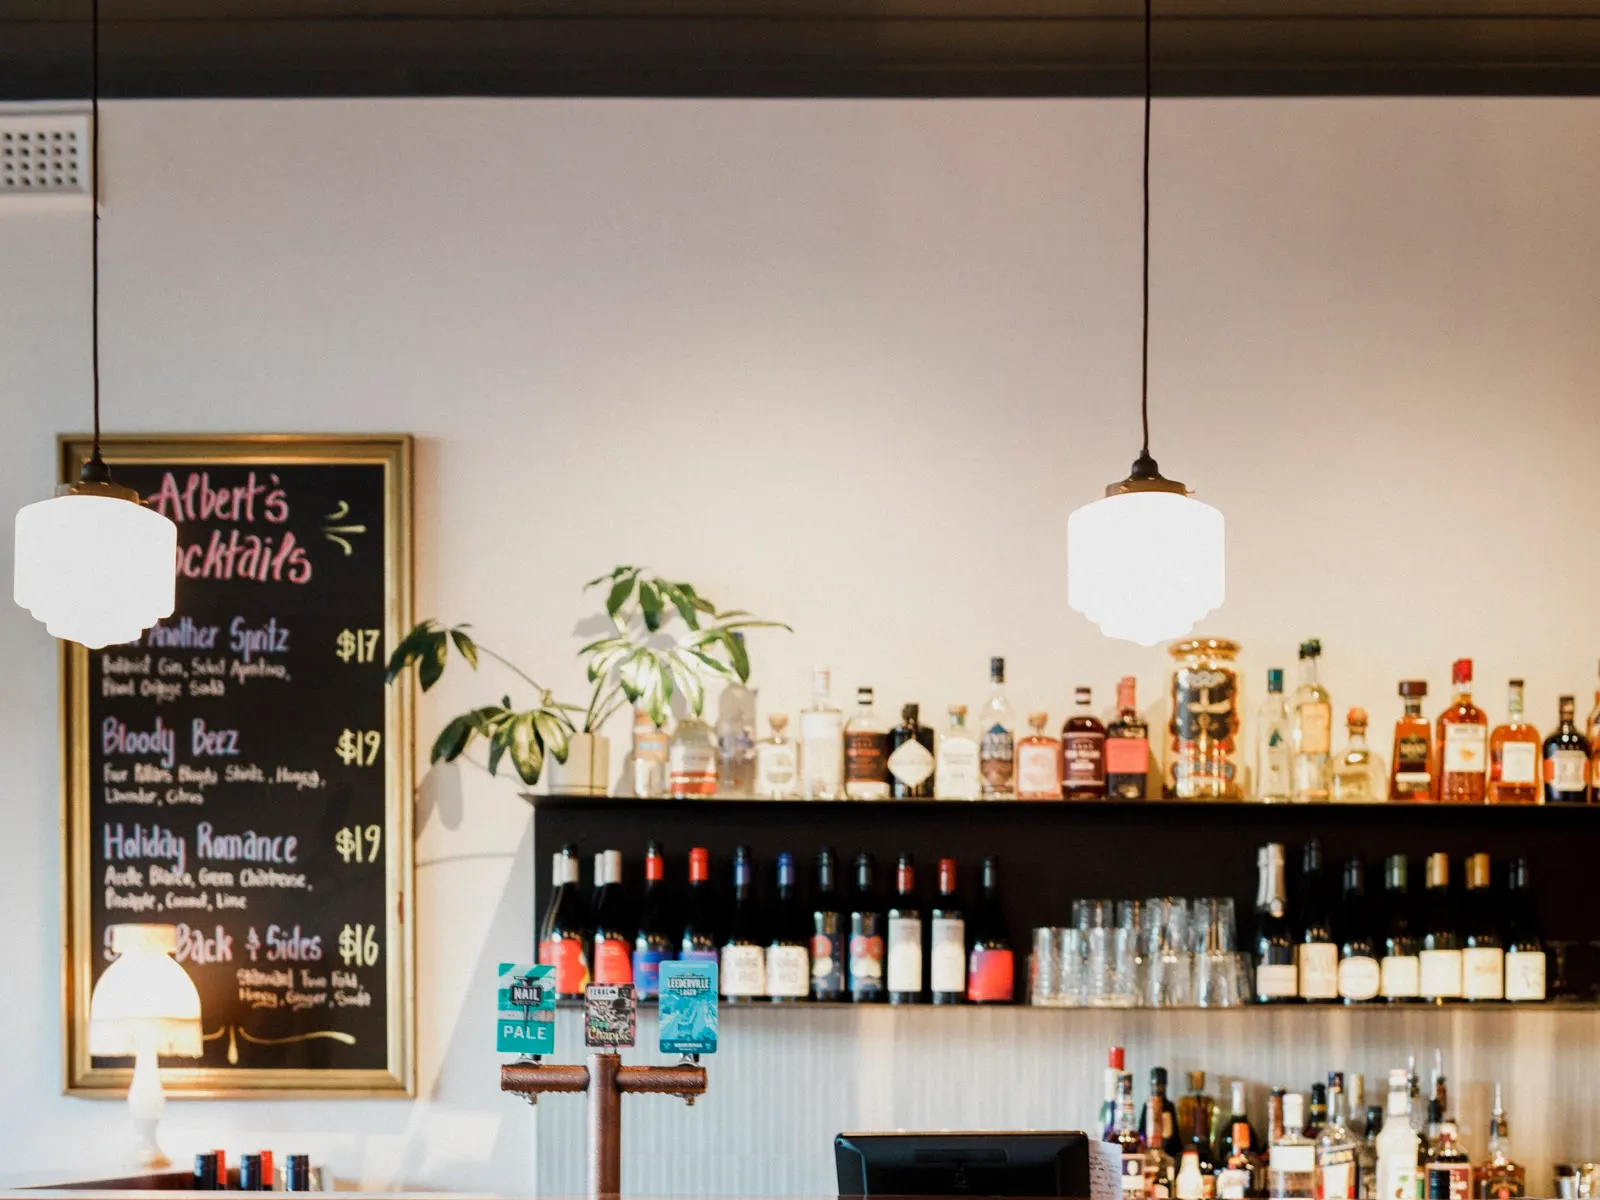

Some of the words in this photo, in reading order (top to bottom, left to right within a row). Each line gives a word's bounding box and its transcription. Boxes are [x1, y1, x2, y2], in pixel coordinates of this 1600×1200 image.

[149, 471, 288, 523] Albert's
[148, 616, 220, 648] Another
[229, 615, 290, 663] Spritz
[336, 628, 381, 663] $17
[102, 715, 176, 769] Bloody
[335, 728, 381, 766] $19
[103, 822, 187, 874] Holiday
[196, 821, 298, 864] Romance
[335, 824, 381, 864] $19
[175, 922, 234, 965] Back
[266, 923, 323, 961] Sides
[338, 922, 381, 967] $16
[513, 987, 540, 1002] NAIL
[668, 978, 710, 989] LEEDERVILLE
[503, 1025, 547, 1041] PALE
